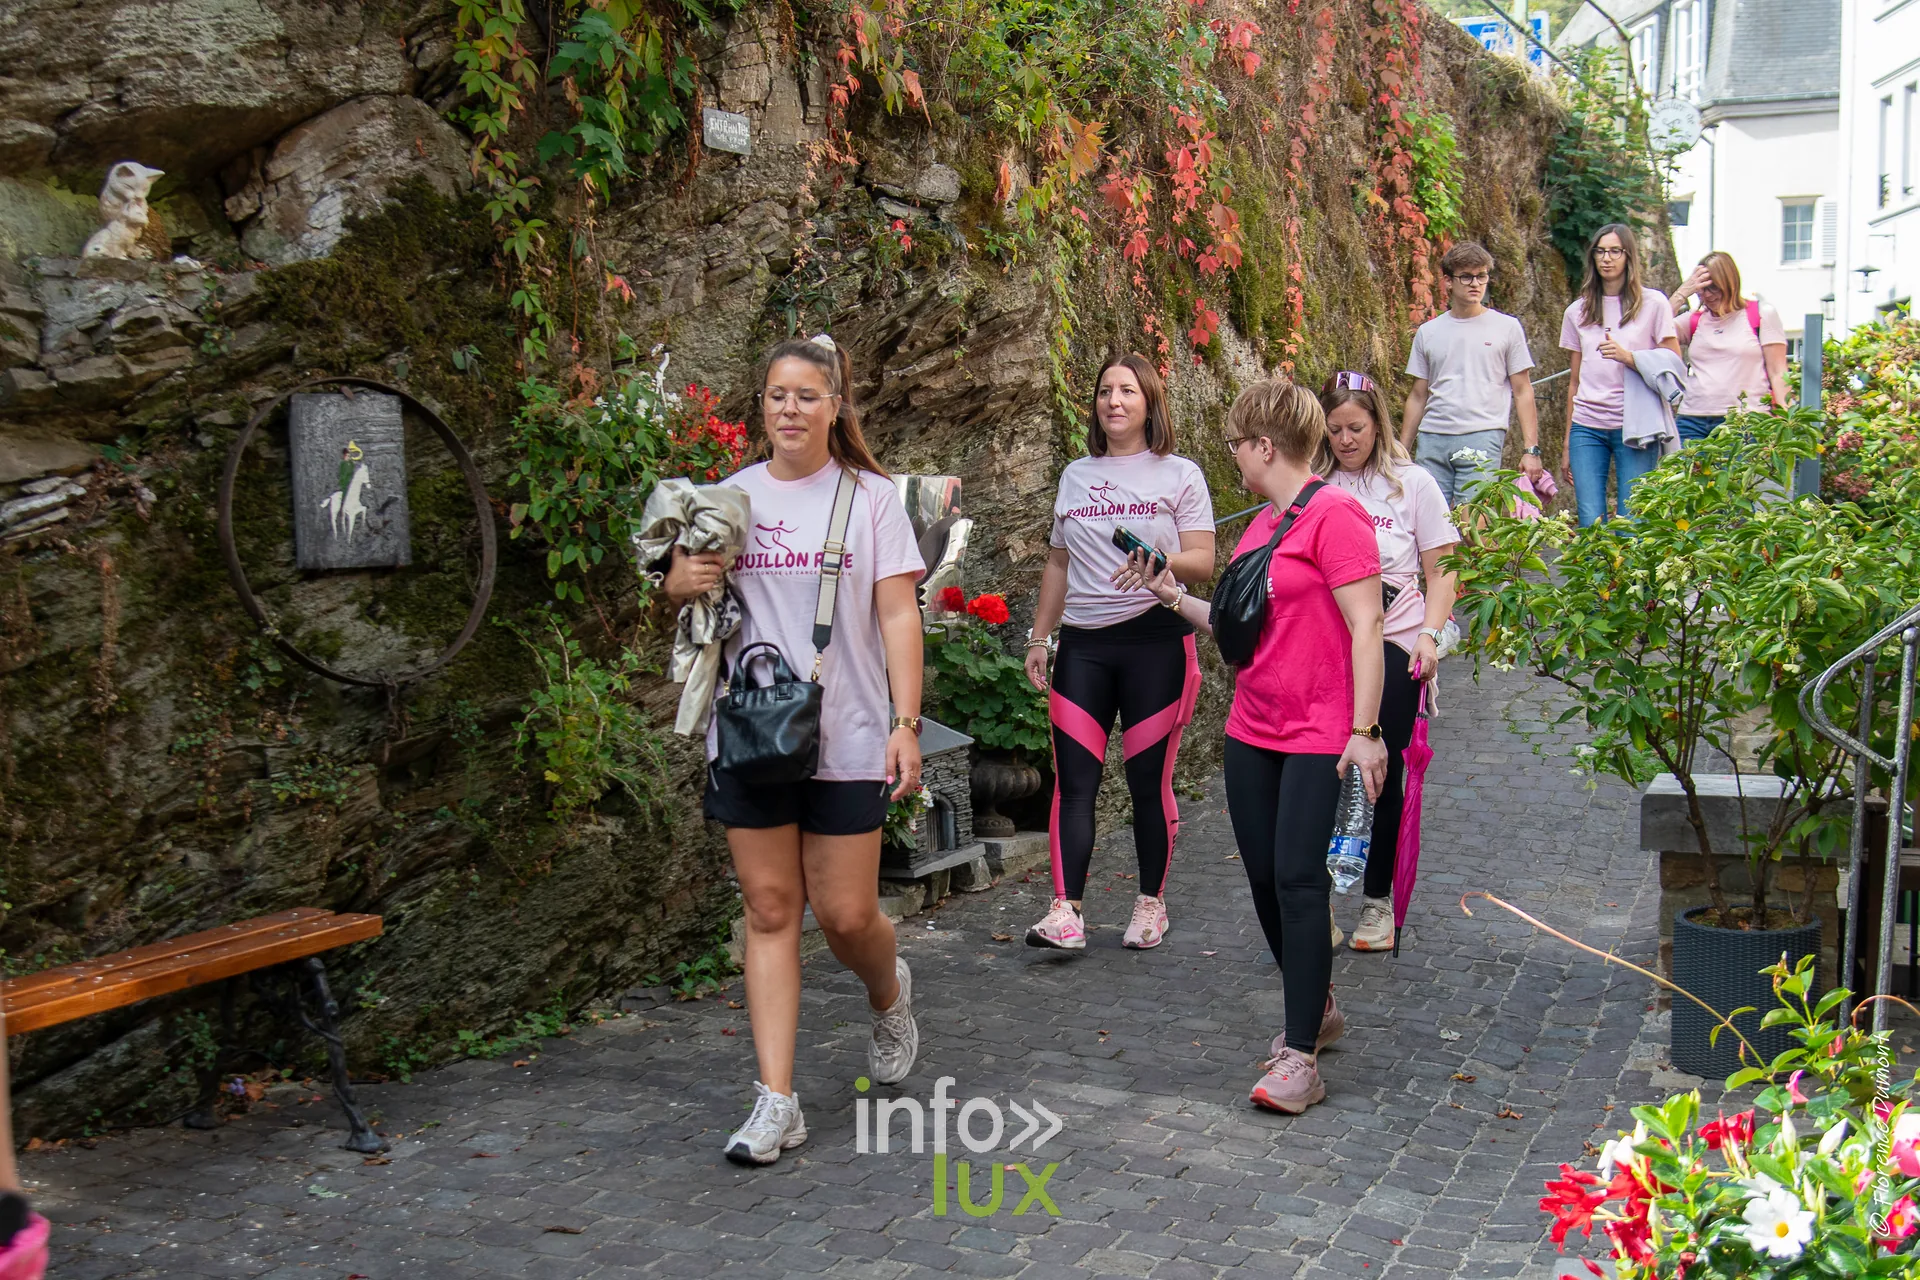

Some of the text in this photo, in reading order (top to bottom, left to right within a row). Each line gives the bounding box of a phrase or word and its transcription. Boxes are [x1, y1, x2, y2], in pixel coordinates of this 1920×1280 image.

[1129, 501, 1158, 515] ROSE
[1370, 515, 1393, 529] OSE
[731, 552, 854, 571] OUILLON RE
